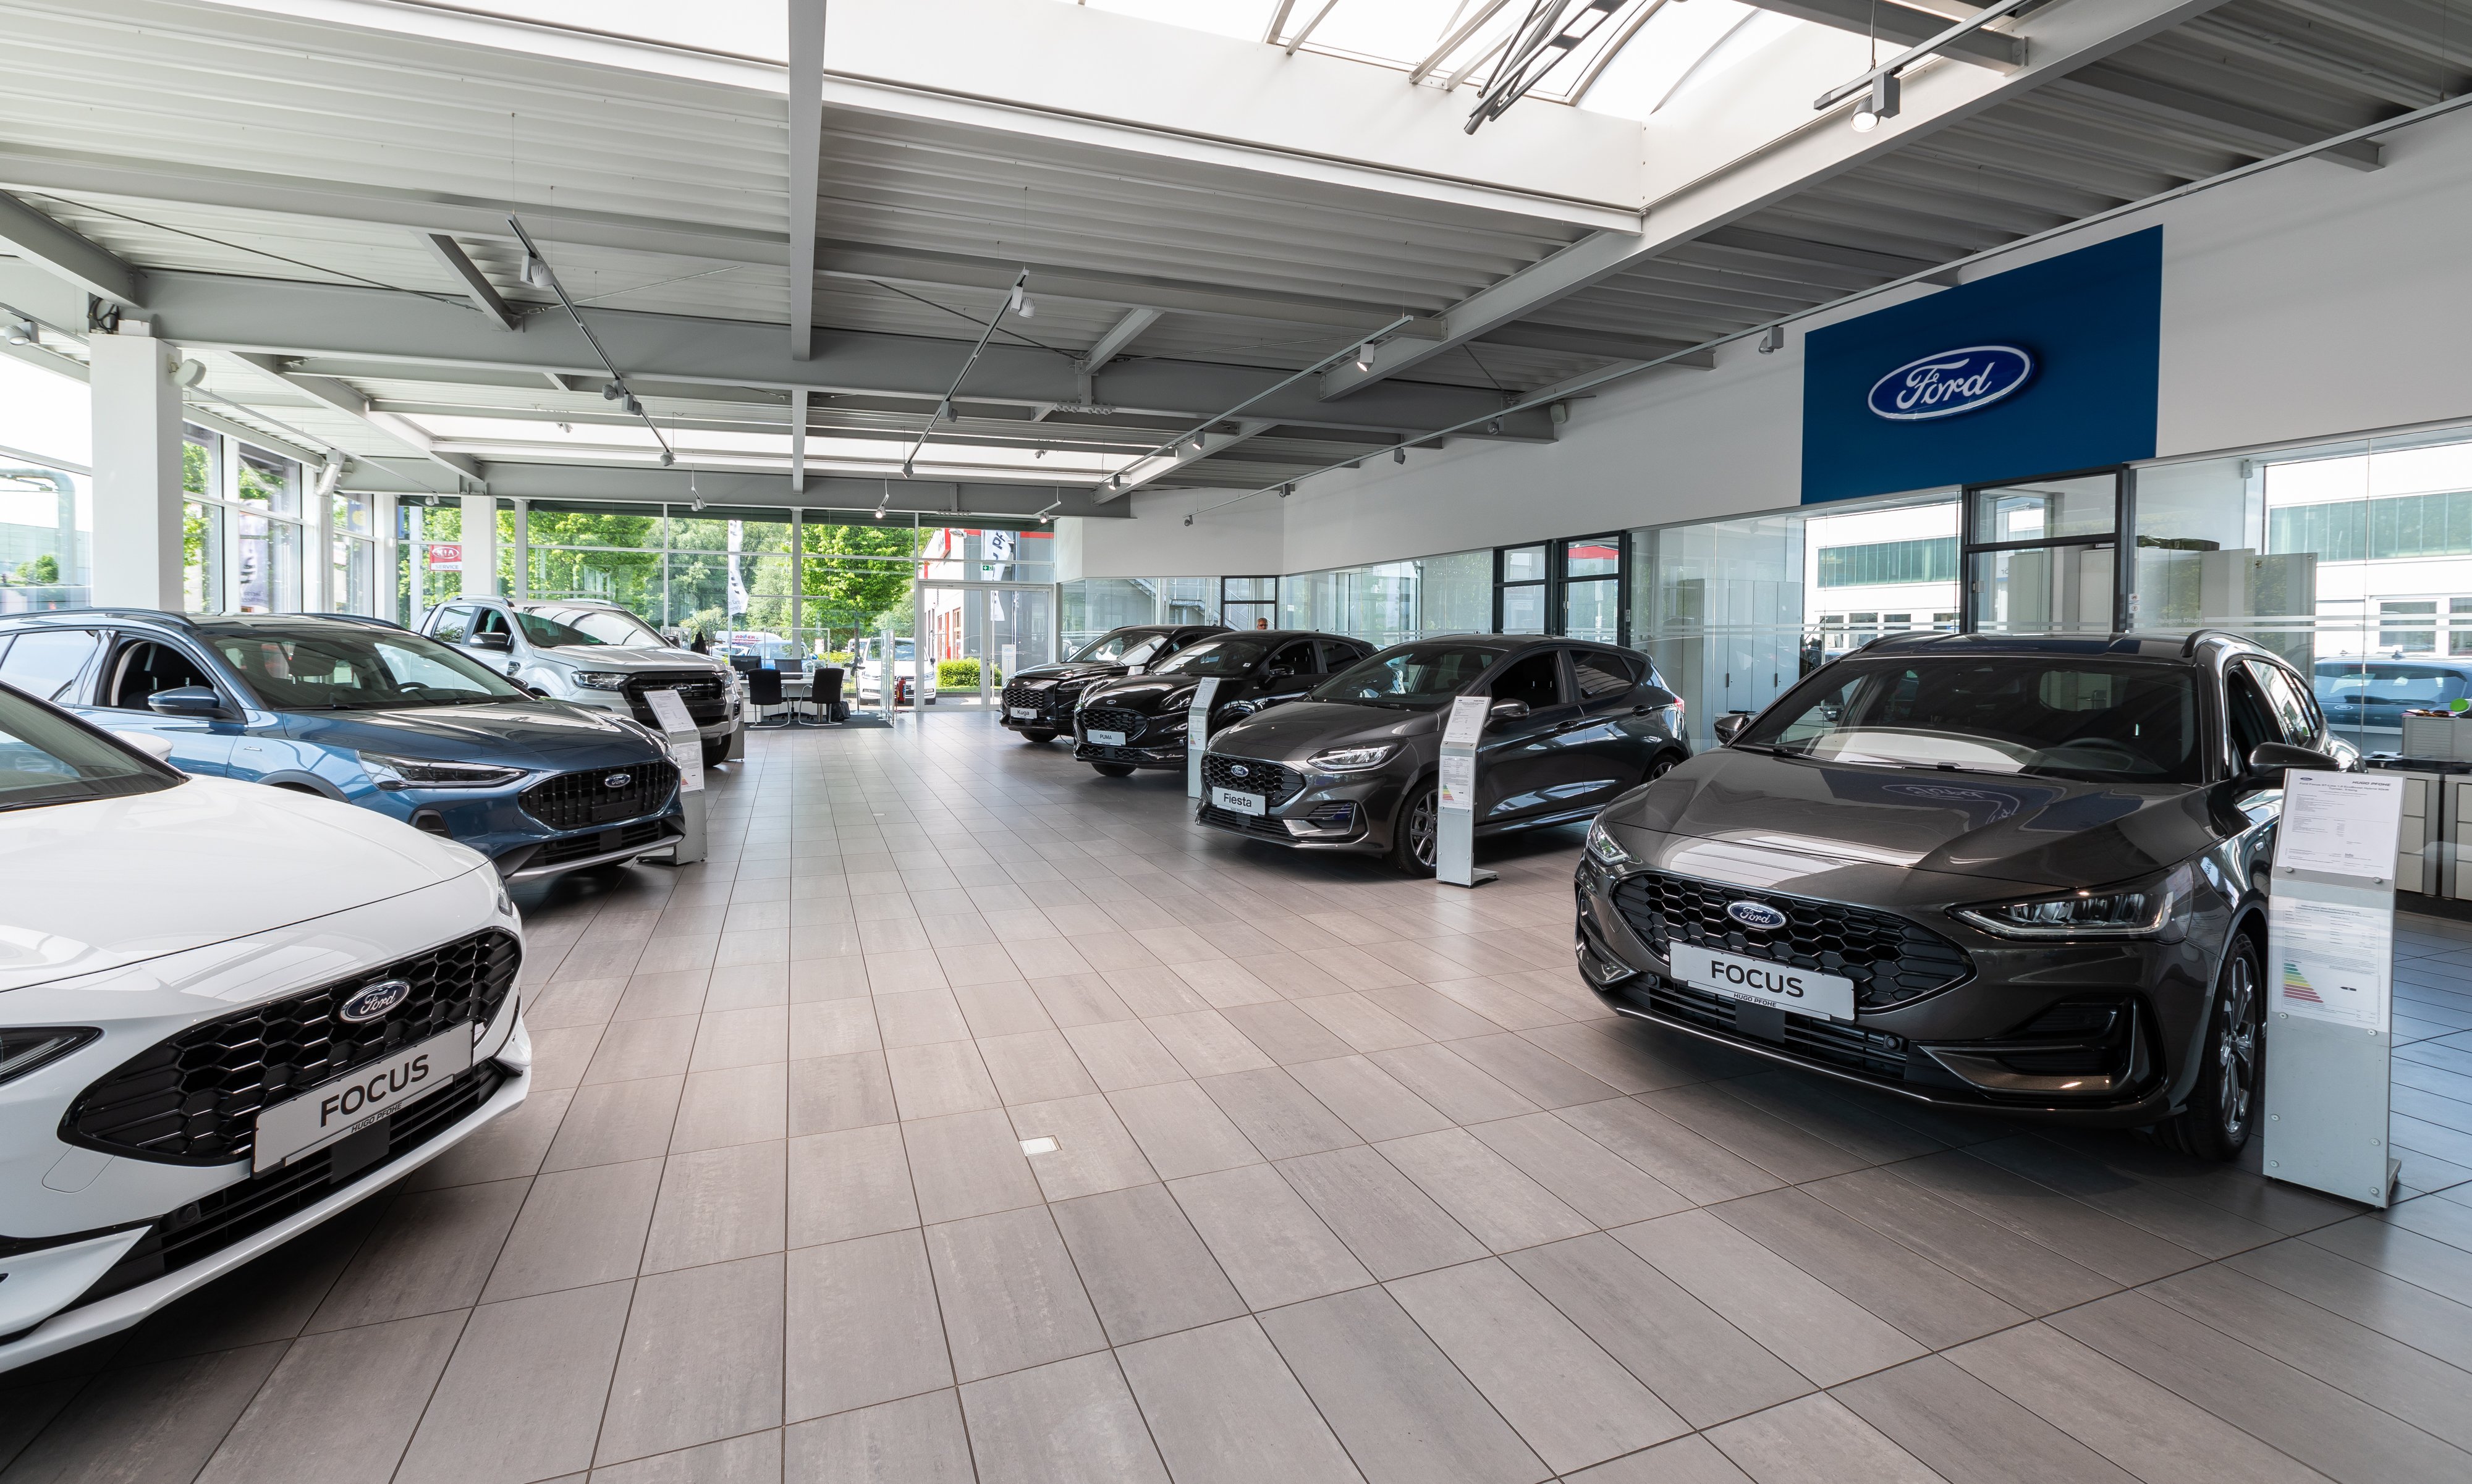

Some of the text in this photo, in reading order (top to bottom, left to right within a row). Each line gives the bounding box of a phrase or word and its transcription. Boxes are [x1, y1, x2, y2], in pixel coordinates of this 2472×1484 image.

[1896, 358, 1995, 409] Ford
[1224, 793, 1252, 807] Fiesta
[1740, 907, 1770, 924] Ford
[1711, 959, 1805, 998] FOCUS
[360, 989, 396, 1014] Ford
[1733, 993, 1777, 1008] HUGO PFOHE
[320, 1054, 430, 1128] FOCUS
[351, 1102, 403, 1134] HUGO PFOHE
